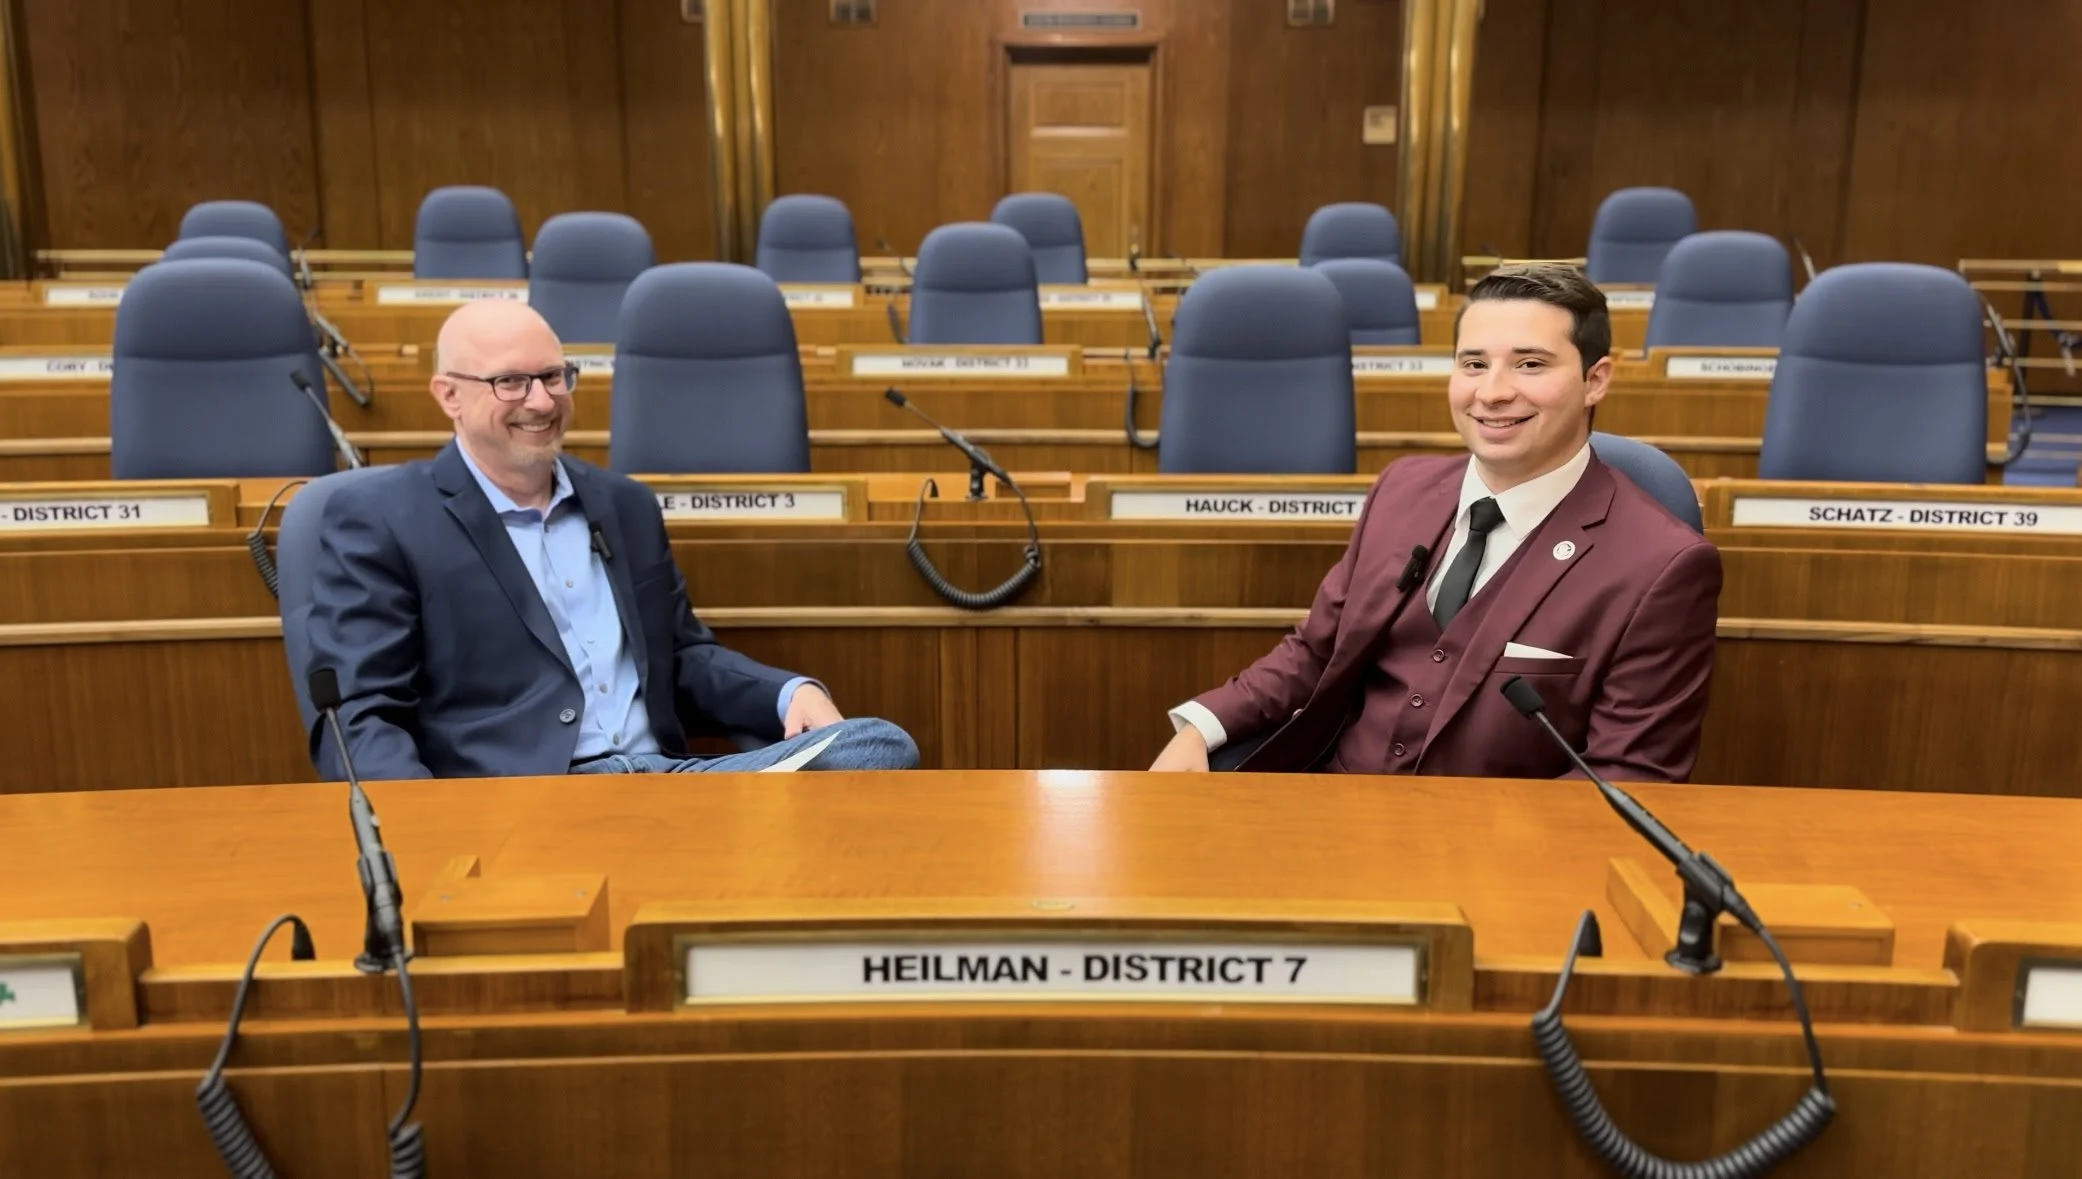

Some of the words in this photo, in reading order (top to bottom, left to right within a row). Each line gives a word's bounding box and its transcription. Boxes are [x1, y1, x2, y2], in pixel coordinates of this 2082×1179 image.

[955, 357, 1010, 369] DISTRICT
[1352, 361, 1404, 371] ISTRICT
[690, 494, 780, 509] DISTRICT
[784, 493, 796, 508] 3
[1185, 499, 1254, 513] HAUCK
[1268, 500, 1357, 515] DISTRICT
[13, 505, 112, 522] DISTRICT
[118, 503, 141, 519] 31
[1809, 506, 1893, 523] SCHATZ
[1909, 509, 2009, 526] DISTRICT
[2013, 511, 2039, 526] 39
[862, 954, 1050, 983] HEILMAN
[1083, 953, 1274, 984] DISTRICT
[1284, 956, 1308, 983] 7
